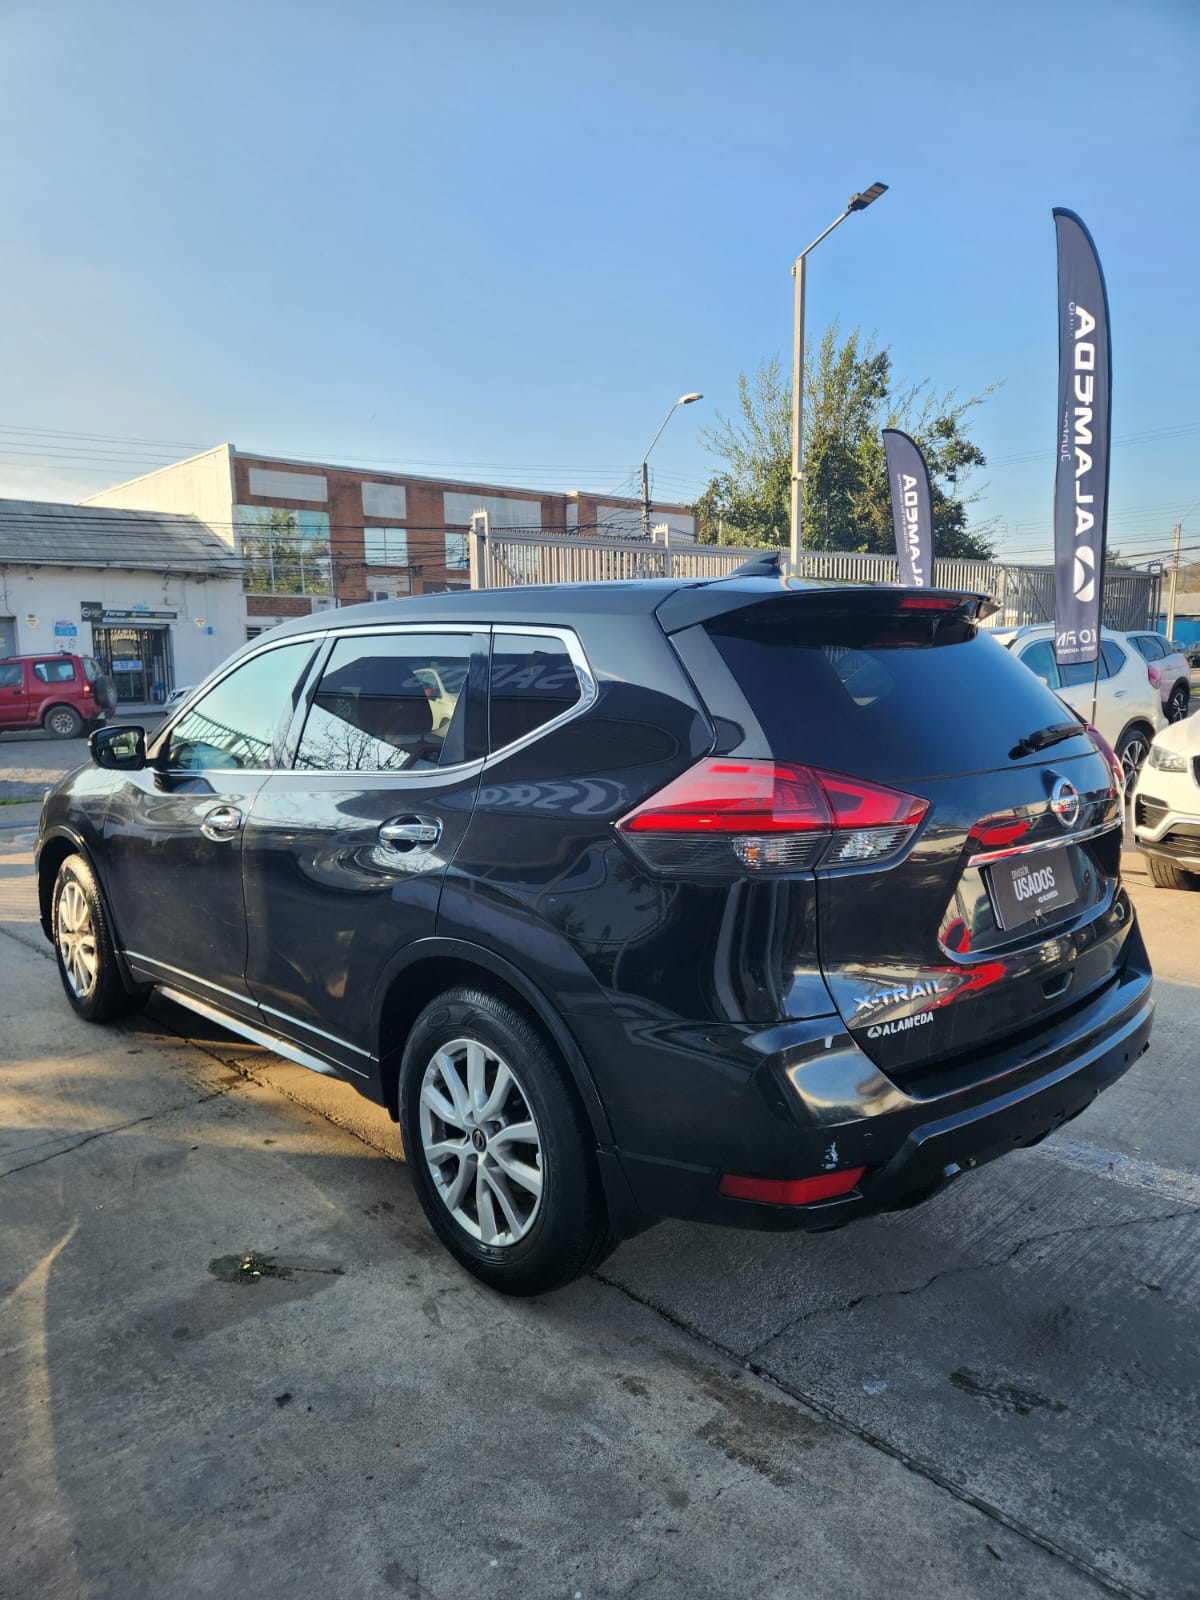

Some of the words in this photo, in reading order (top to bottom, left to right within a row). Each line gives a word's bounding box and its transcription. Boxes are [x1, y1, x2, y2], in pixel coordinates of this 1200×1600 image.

[1013, 866, 1055, 901] USADOS
[853, 978, 948, 1013] X-TRAIL
[882, 1010, 934, 1037] ALAMEDA
